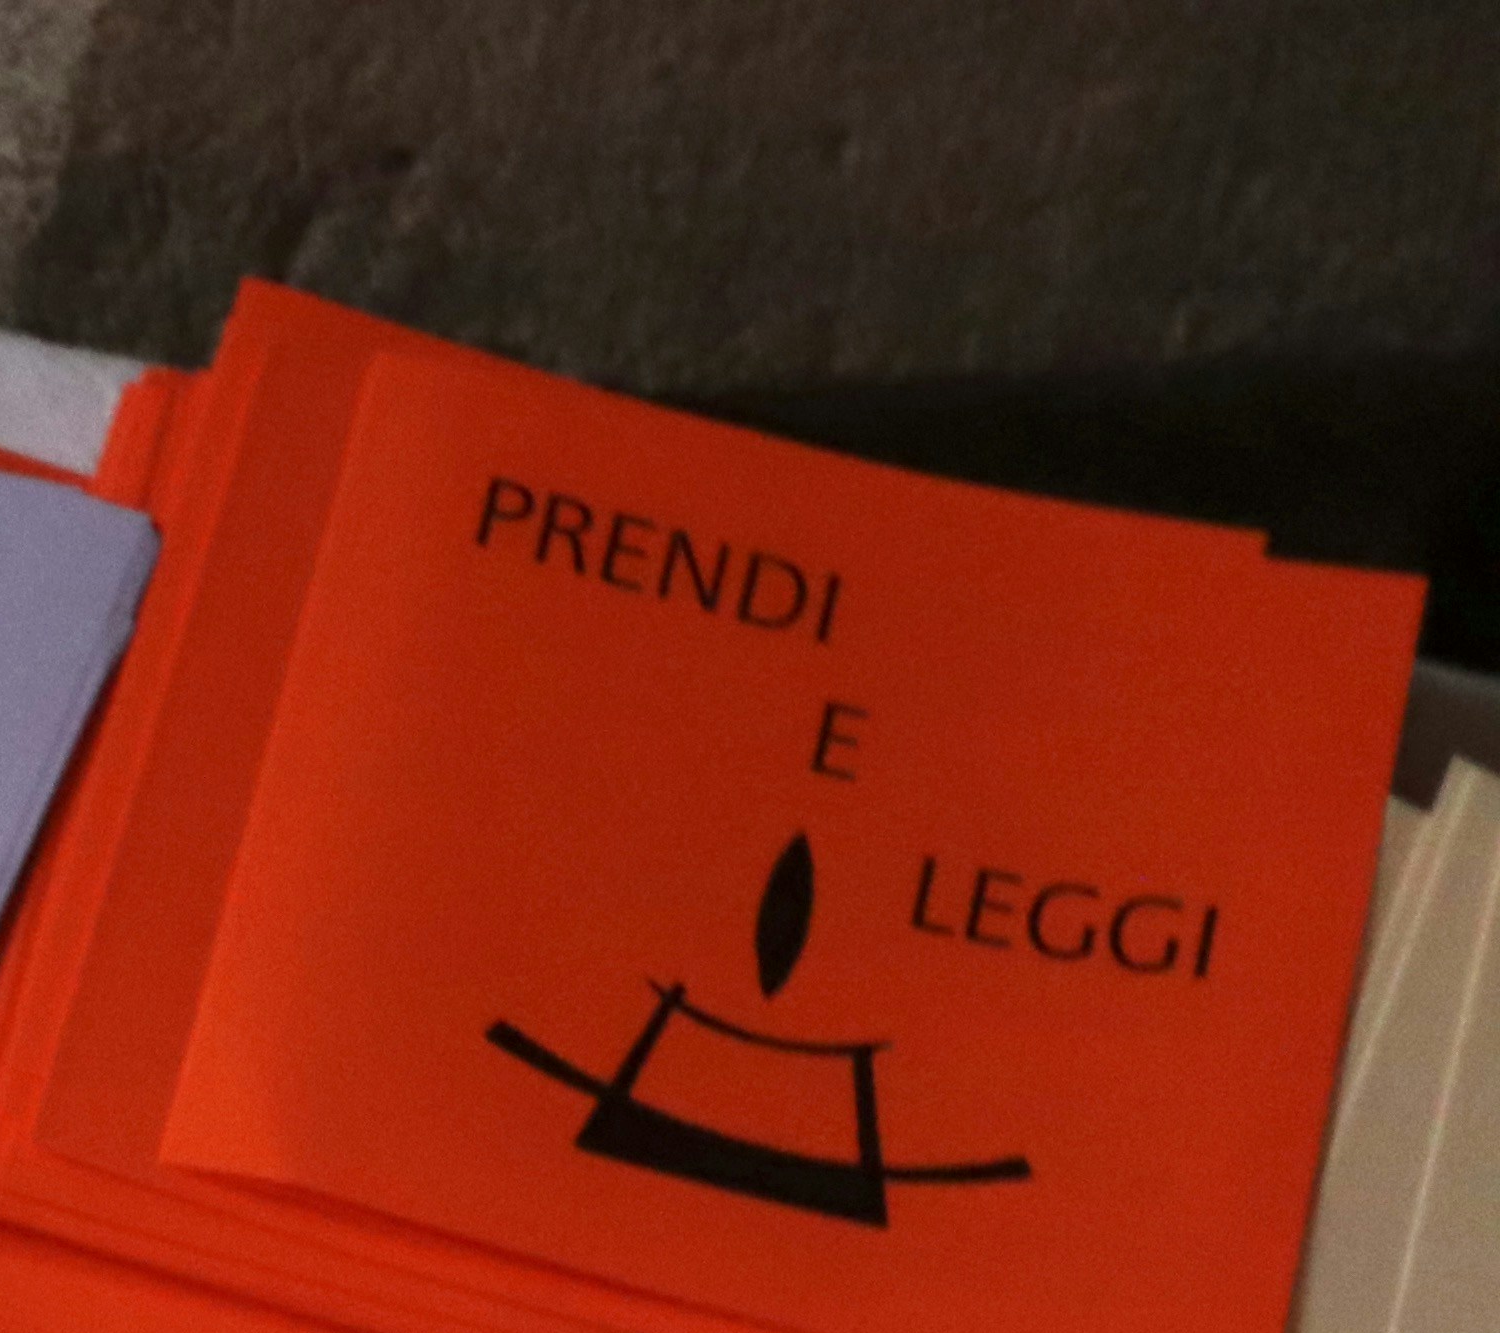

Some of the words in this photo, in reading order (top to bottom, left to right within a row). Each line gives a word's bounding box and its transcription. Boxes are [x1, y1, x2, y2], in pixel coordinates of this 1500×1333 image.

[476, 477, 842, 644] PRENDI
[811, 702, 865, 779] E
[911, 857, 1218, 978] LEGGI
